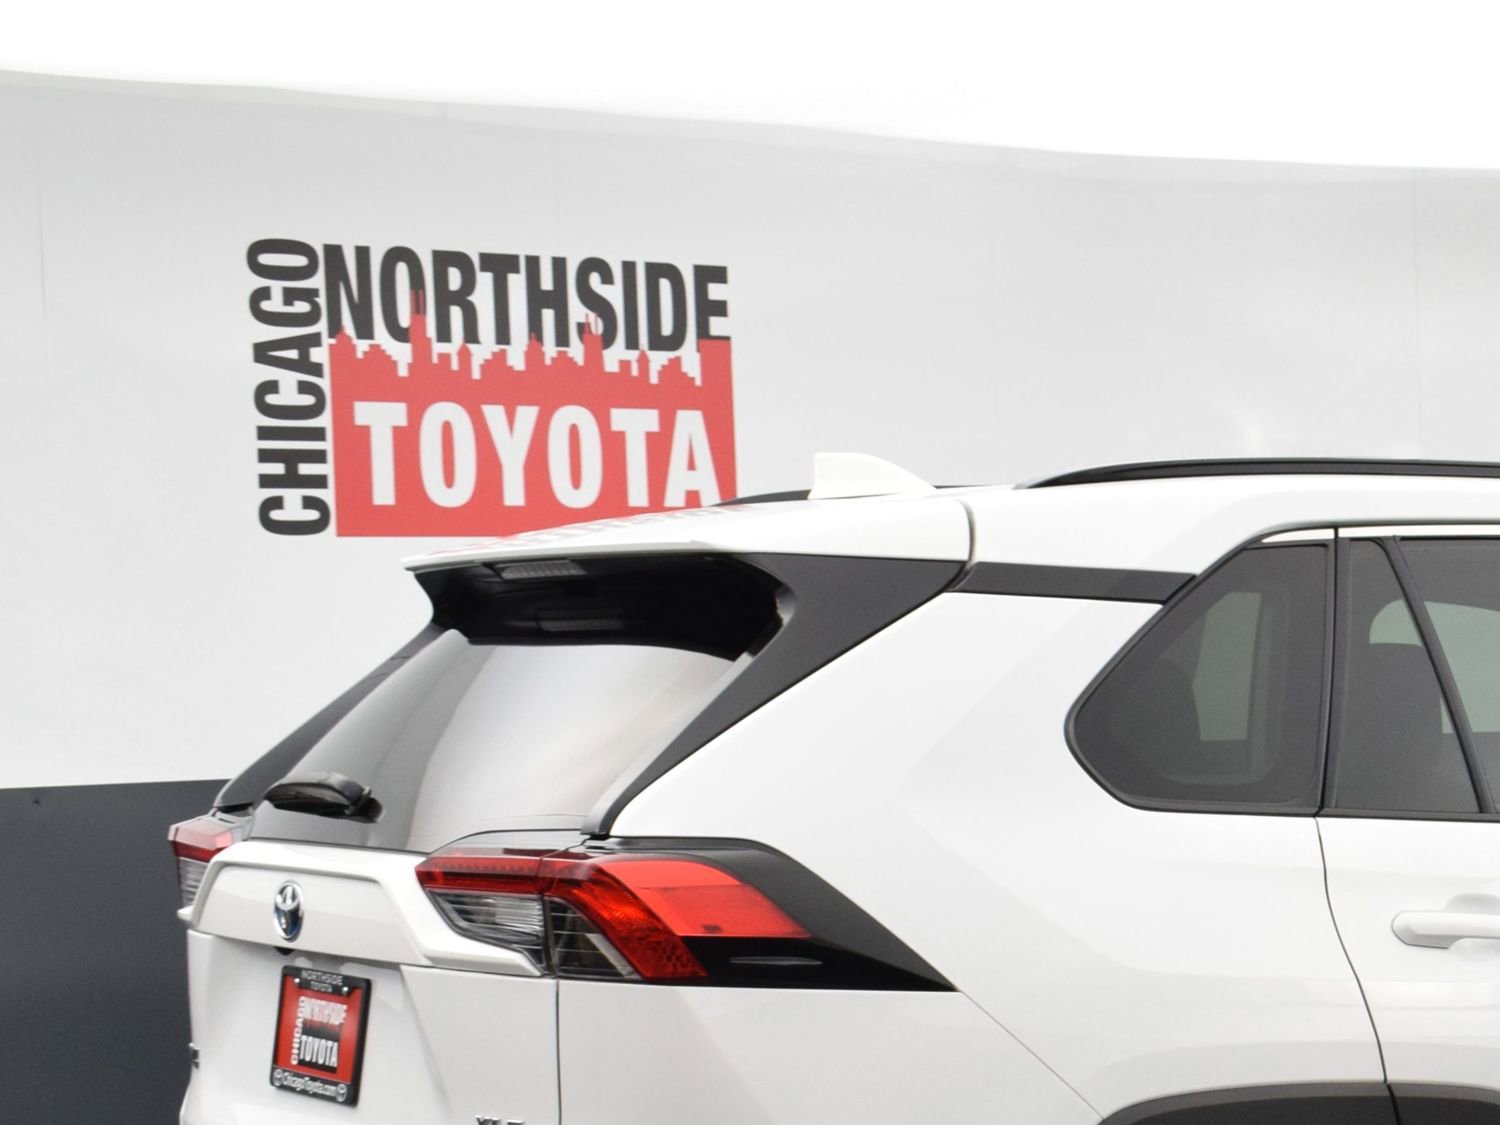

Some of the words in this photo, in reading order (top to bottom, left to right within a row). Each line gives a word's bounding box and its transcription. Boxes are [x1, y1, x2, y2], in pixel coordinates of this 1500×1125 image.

[323, 243, 731, 353] NORTHSIDE
[246, 238, 331, 537] CHICAGO
[353, 401, 722, 508] TOYOTA
[301, 970, 343, 986] NORTHSIDE
[303, 997, 348, 1026] NORTHSIDE
[300, 1034, 339, 1068] TOYOTA
